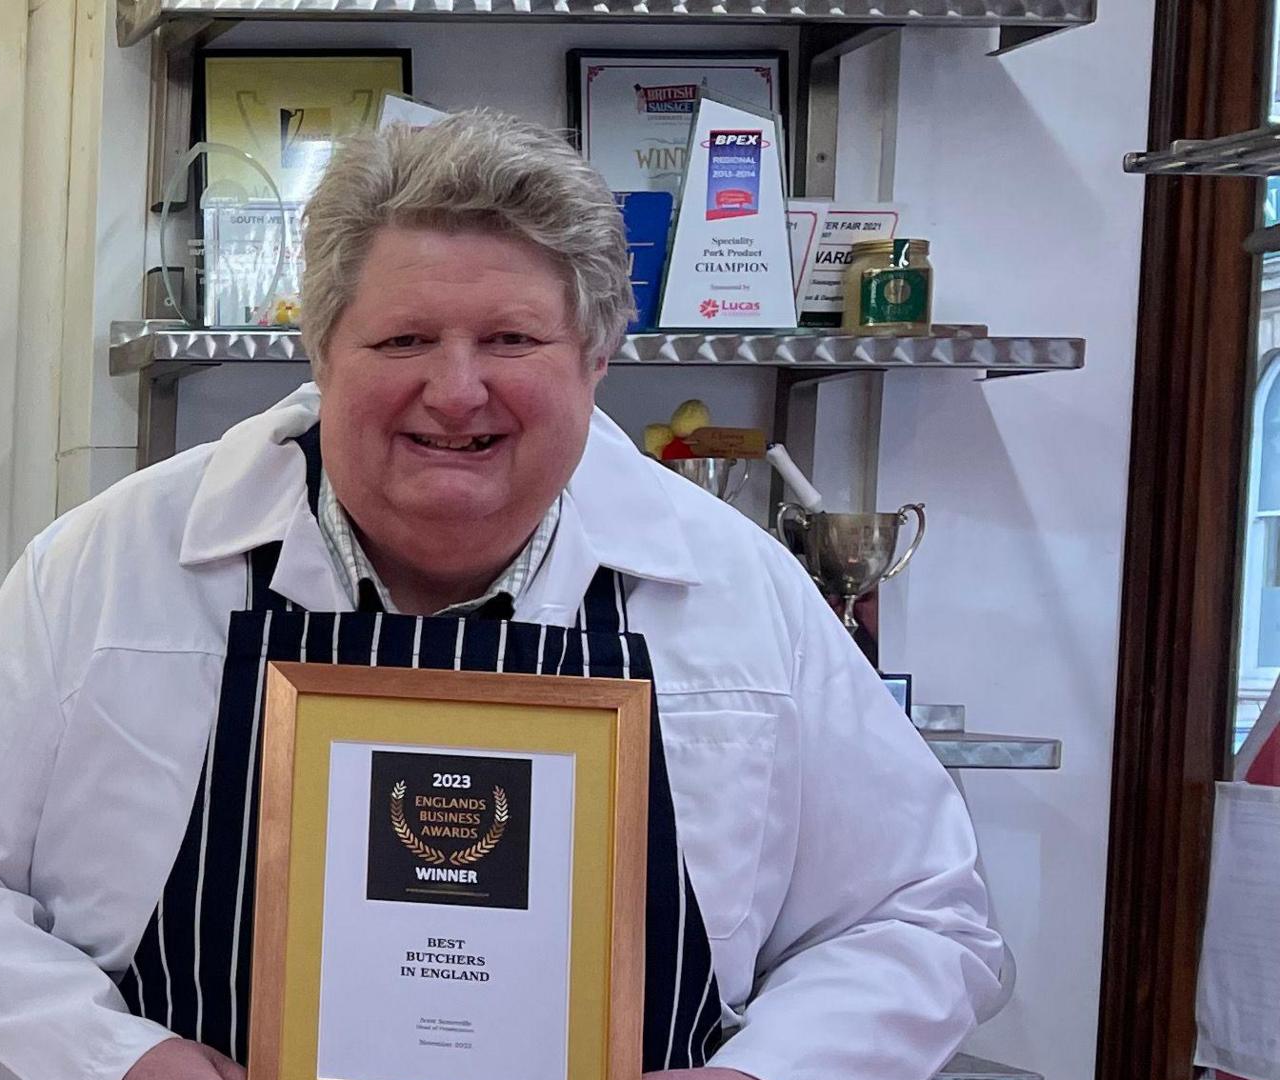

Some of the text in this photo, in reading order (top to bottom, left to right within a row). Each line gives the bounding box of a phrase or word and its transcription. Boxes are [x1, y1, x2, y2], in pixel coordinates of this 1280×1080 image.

[647, 87, 693, 100] BRITISH
[648, 102, 691, 112] SAUSAGE
[715, 135, 759, 146] BPEX
[727, 249, 762, 257] Product
[695, 262, 769, 273] CHAMPION
[721, 299, 760, 311] Lucas
[432, 773, 472, 789] 2023
[415, 795, 487, 811] ENGLANDS
[419, 810, 481, 826] BUSINESS
[420, 826, 479, 840] AWARDS
[415, 866, 478, 884] WINNER
[427, 937, 466, 950] BEST
[406, 951, 486, 967] BUTCHERS
[400, 965, 490, 983] IN ENGLAND
